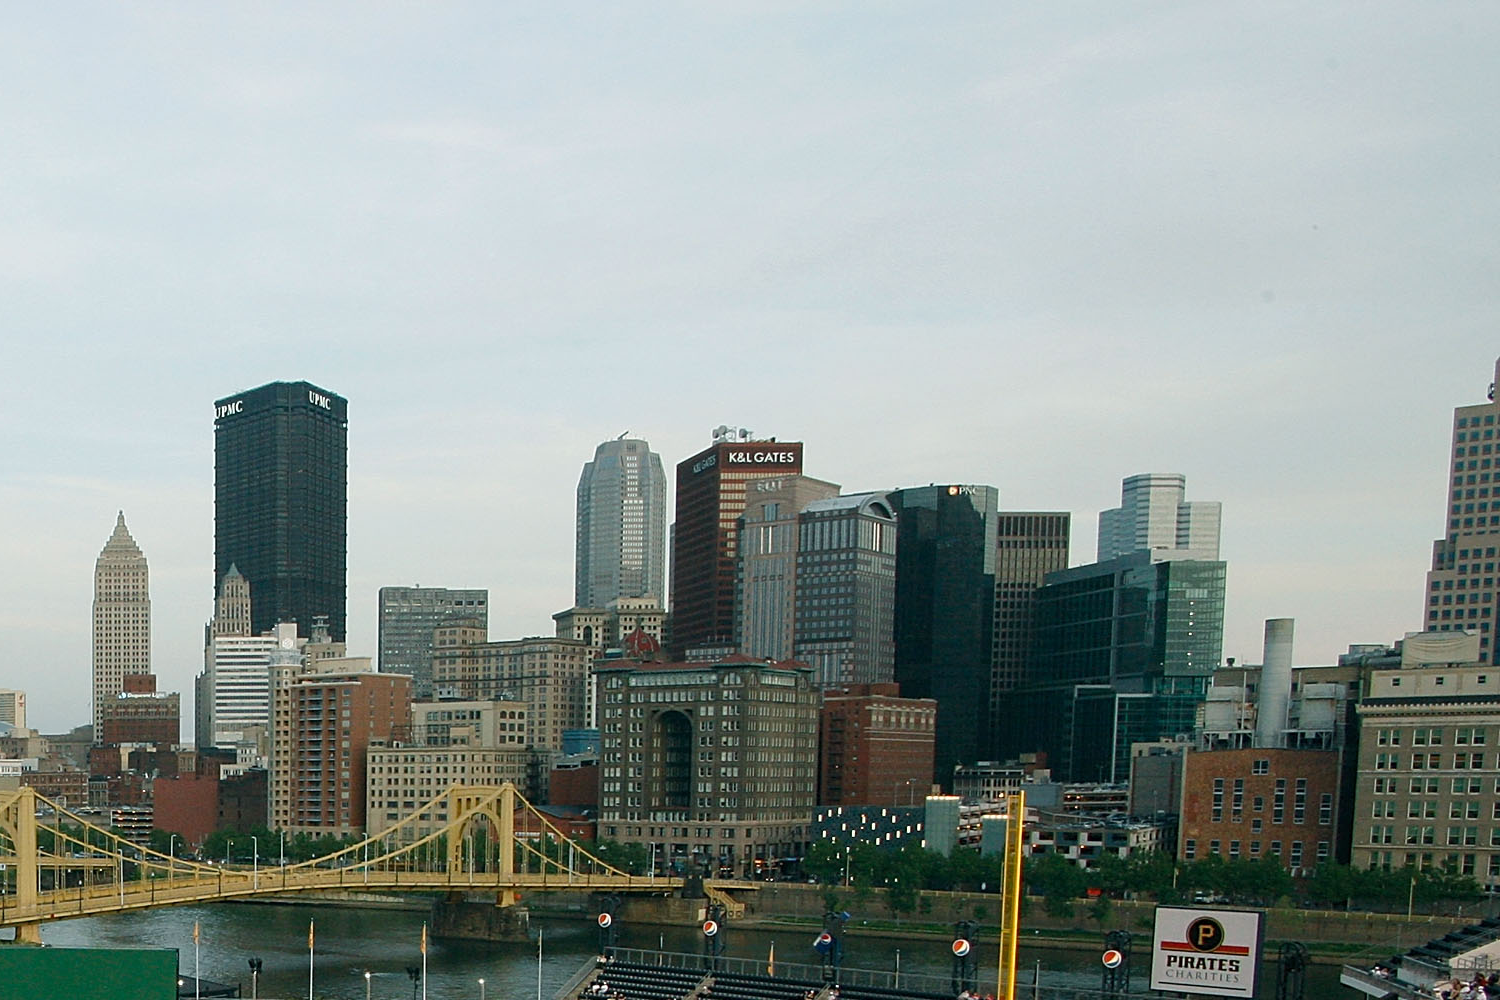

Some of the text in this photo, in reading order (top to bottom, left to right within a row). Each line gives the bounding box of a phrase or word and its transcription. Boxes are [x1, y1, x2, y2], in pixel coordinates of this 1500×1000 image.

[308, 390, 331, 410] UPMC
[214, 400, 243, 419] UPMC
[728, 452, 794, 463] K&L GATES
[1197, 924, 1215, 945] P
[1166, 955, 1240, 973] PIRATES
[1165, 969, 1239, 983] CHARITIES
